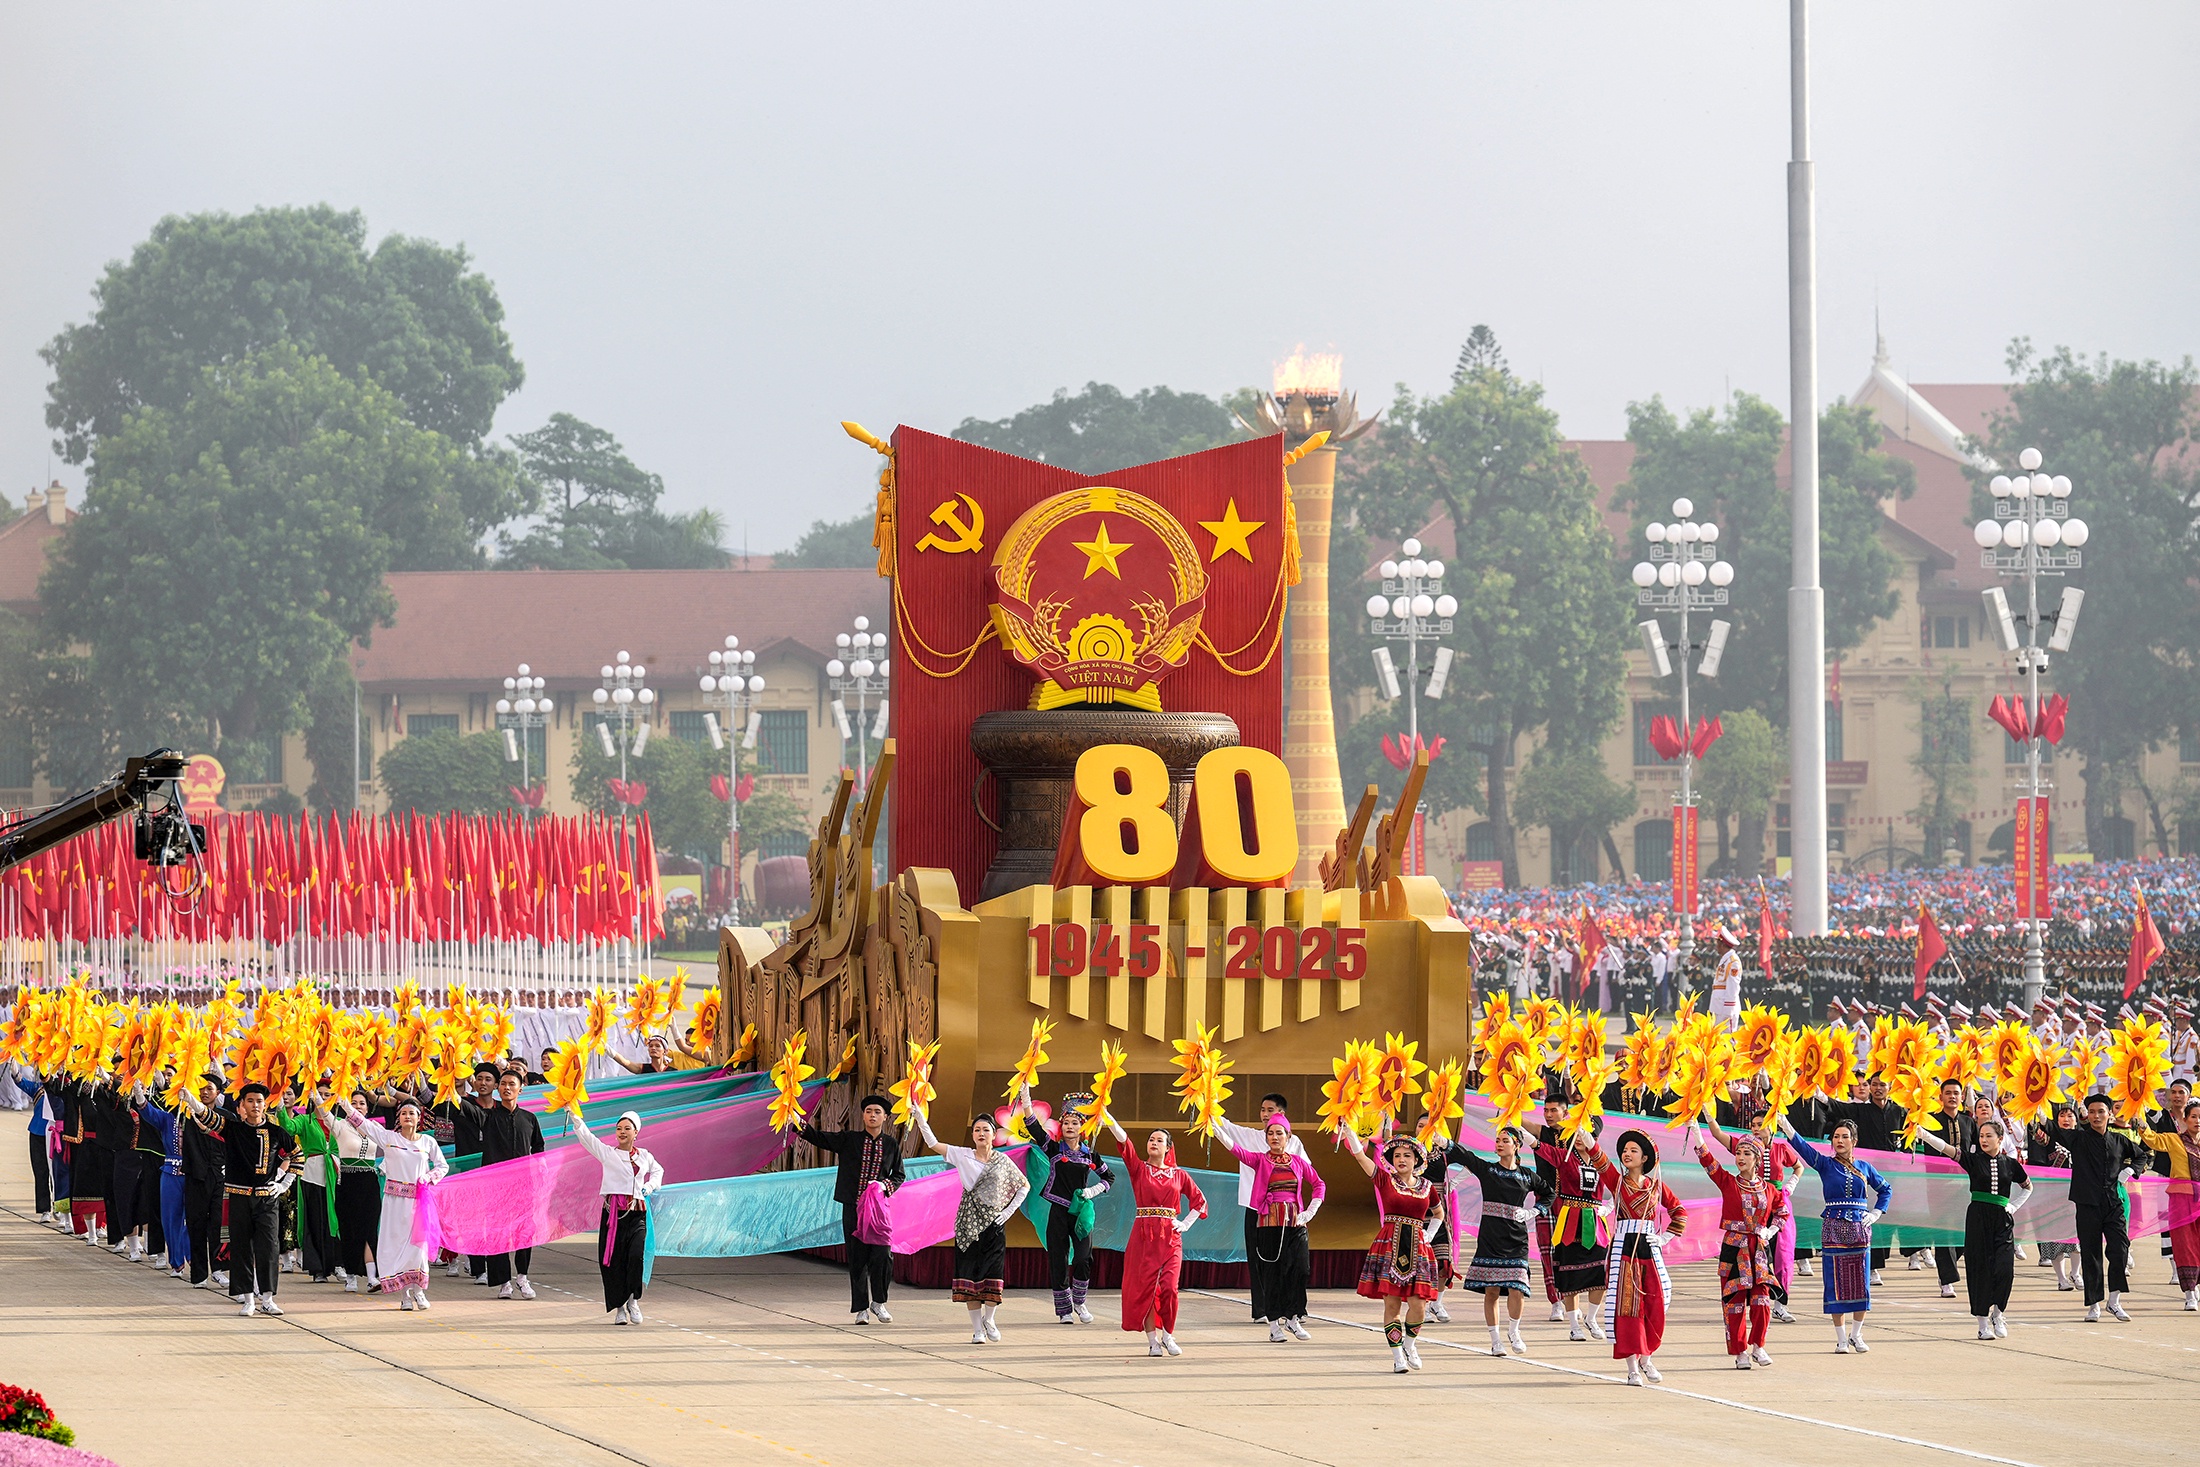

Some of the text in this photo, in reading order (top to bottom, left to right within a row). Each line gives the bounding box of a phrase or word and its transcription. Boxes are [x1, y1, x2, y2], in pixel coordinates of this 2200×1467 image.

[1069, 669, 1135, 686] VIỆT NAM
[1074, 743, 1299, 882] 80
[1028, 923, 1161, 978] 1945
[1225, 926, 1368, 980] 2025
